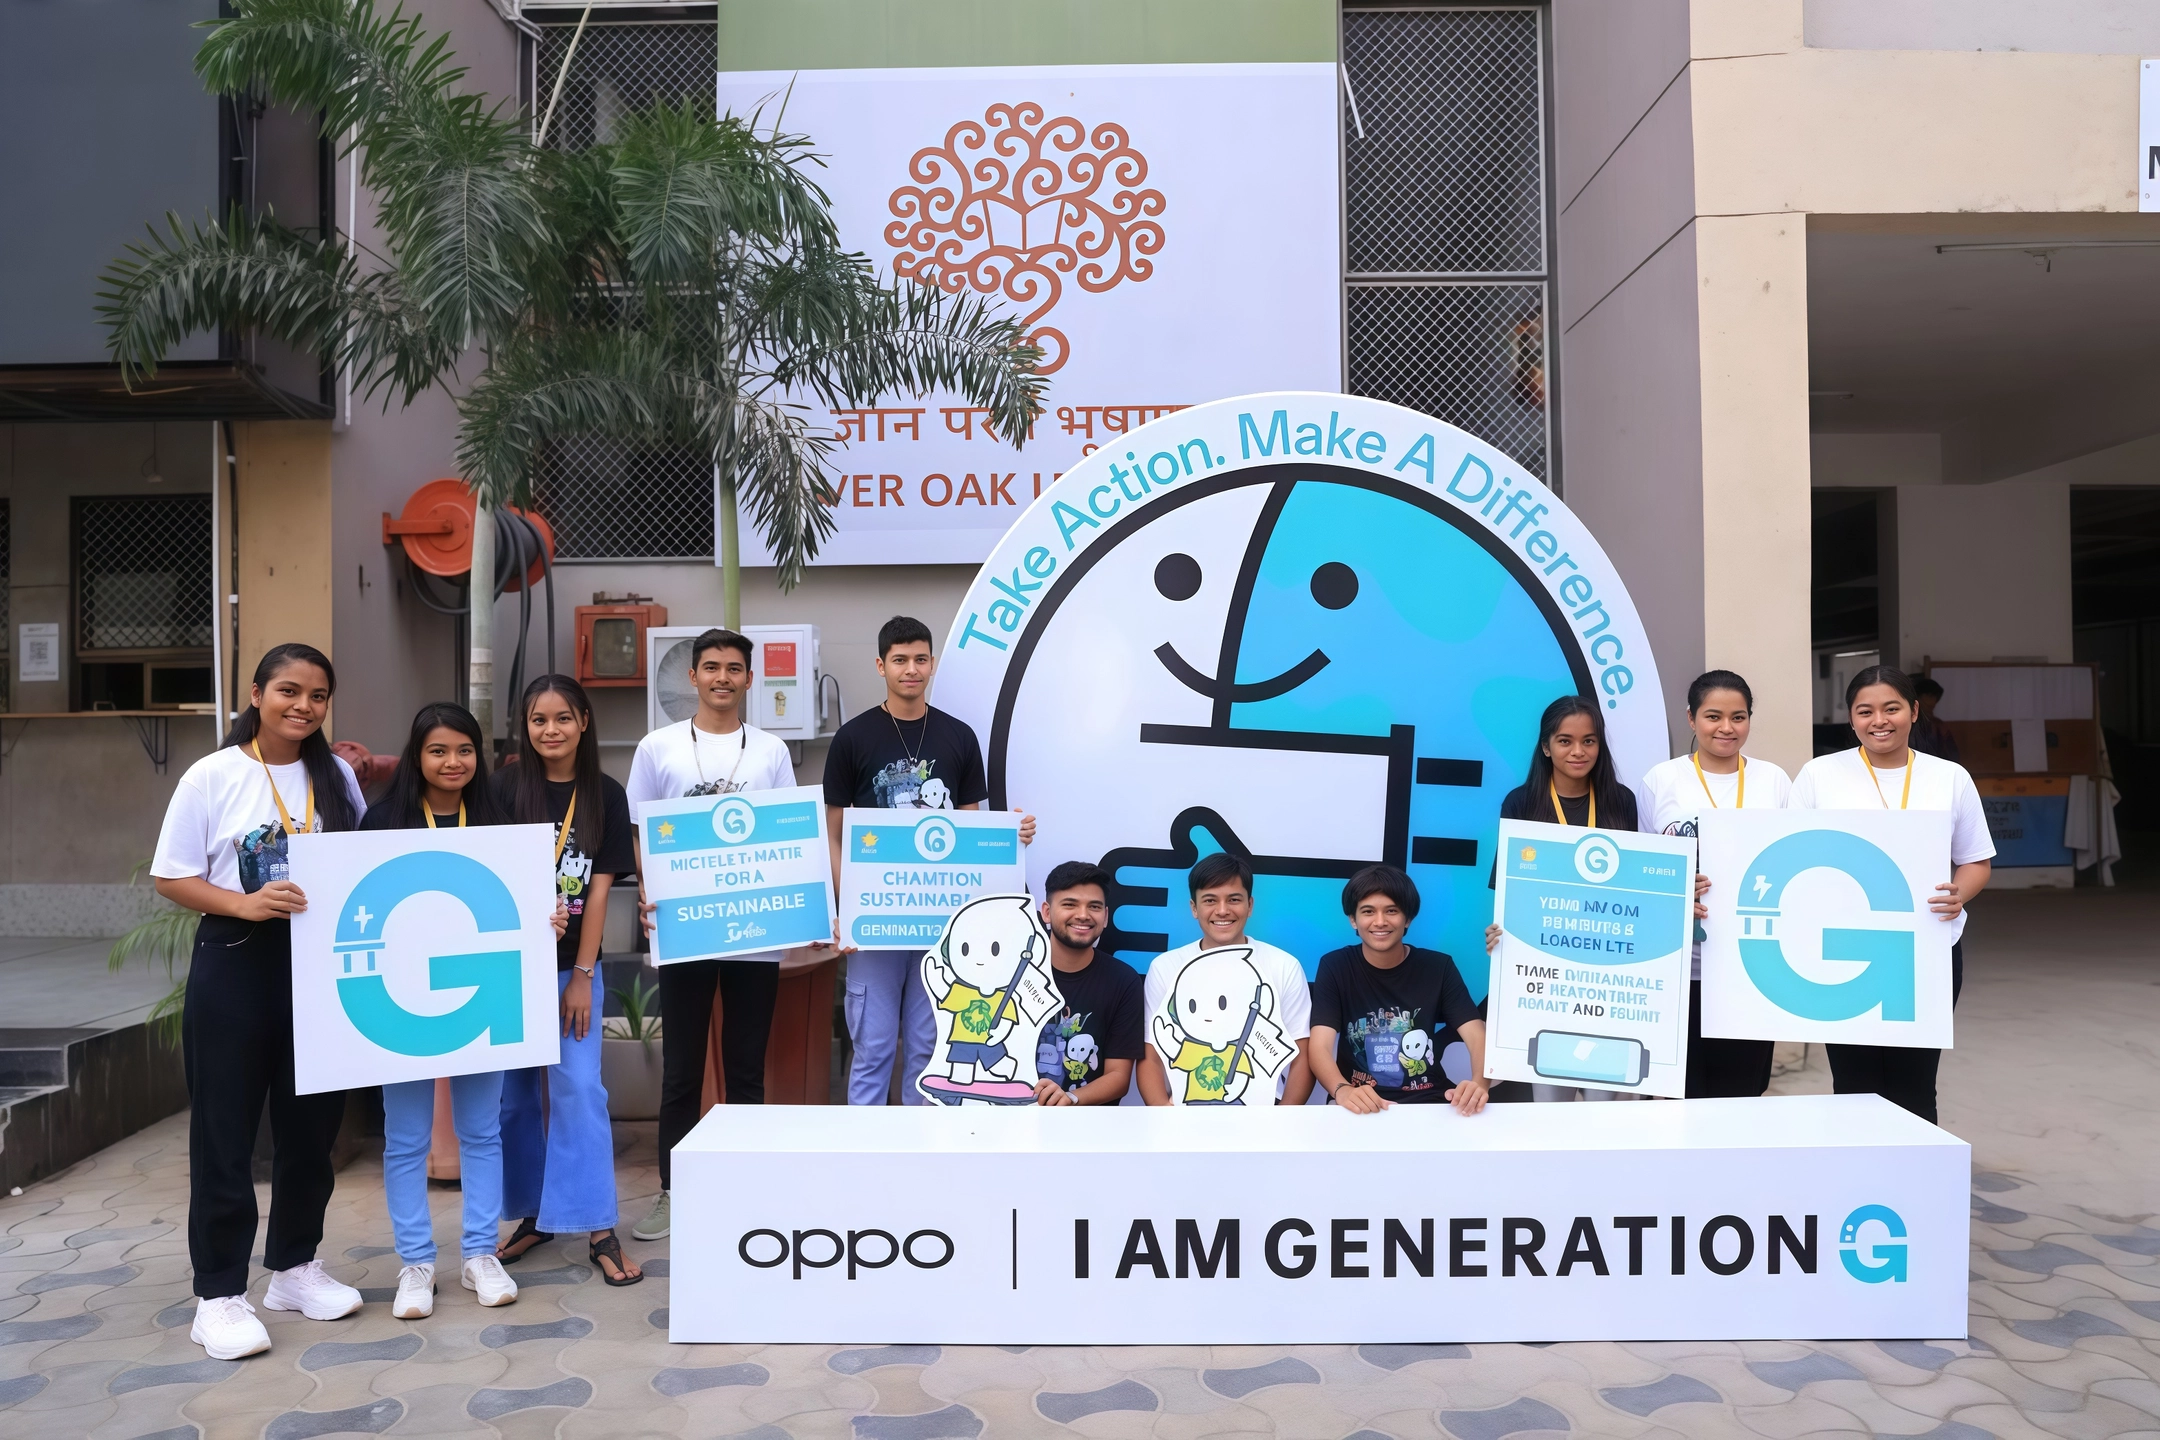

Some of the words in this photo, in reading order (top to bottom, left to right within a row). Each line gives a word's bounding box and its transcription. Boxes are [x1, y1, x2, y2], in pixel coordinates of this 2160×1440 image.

[828, 474, 905, 507] VER
[921, 472, 1017, 507] OAK
[957, 544, 1060, 654] Take
[1049, 436, 1227, 552] Action.
[1238, 408, 1387, 464] Make
[1394, 432, 1436, 485] A
[1445, 452, 1635, 710] Difference.
[882, 871, 982, 887] CHAMTION
[677, 892, 806, 922] SUSTAINABLE
[1572, 1002, 1605, 1017] AND
[738, 1228, 955, 1280] oppo
[1074, 1219, 1089, 1279] I
[1114, 1218, 1240, 1279] AM
[1264, 1214, 1818, 1279] GENERATION
